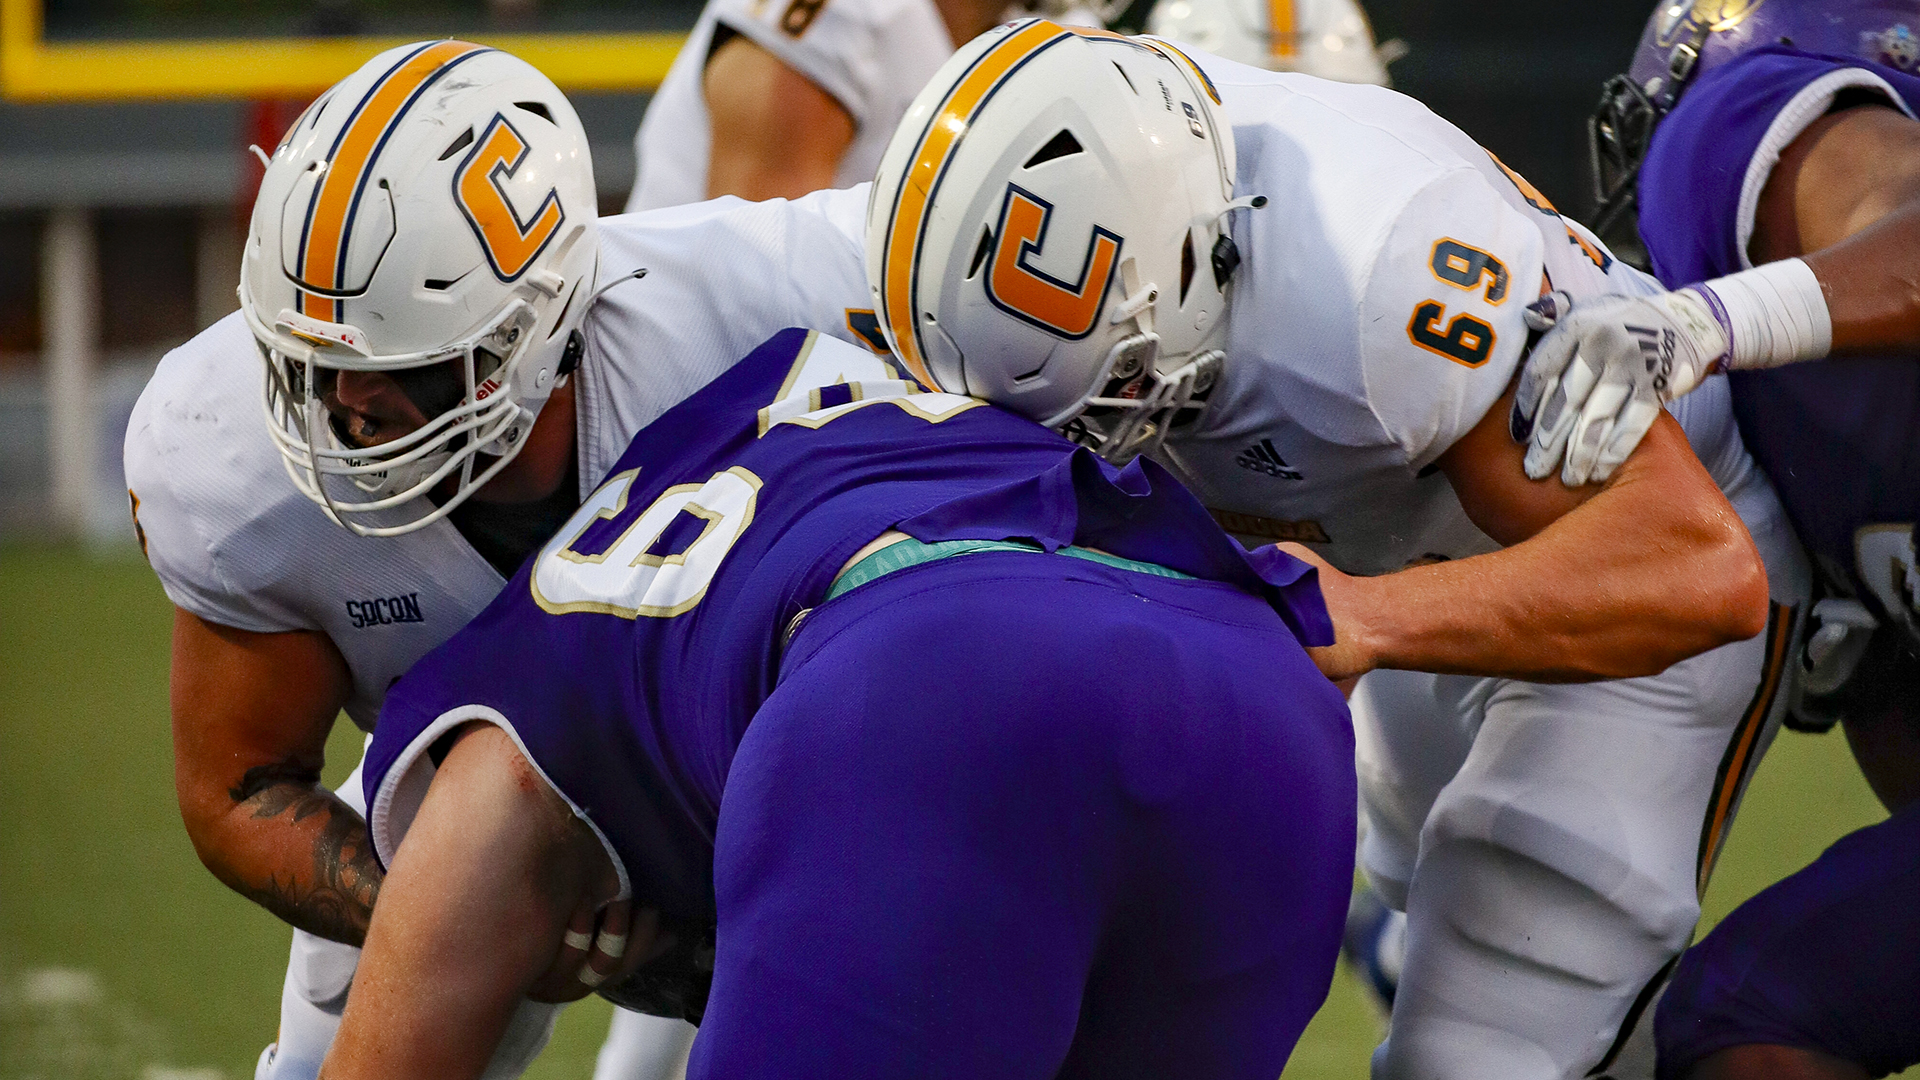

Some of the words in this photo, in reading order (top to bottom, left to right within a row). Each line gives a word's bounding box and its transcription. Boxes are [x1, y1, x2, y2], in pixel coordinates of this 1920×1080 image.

[1180, 101, 1206, 139] 69
[452, 111, 566, 284] C
[984, 181, 1125, 341] C
[1406, 236, 1512, 369] 69
[346, 592, 425, 629] SOCON
